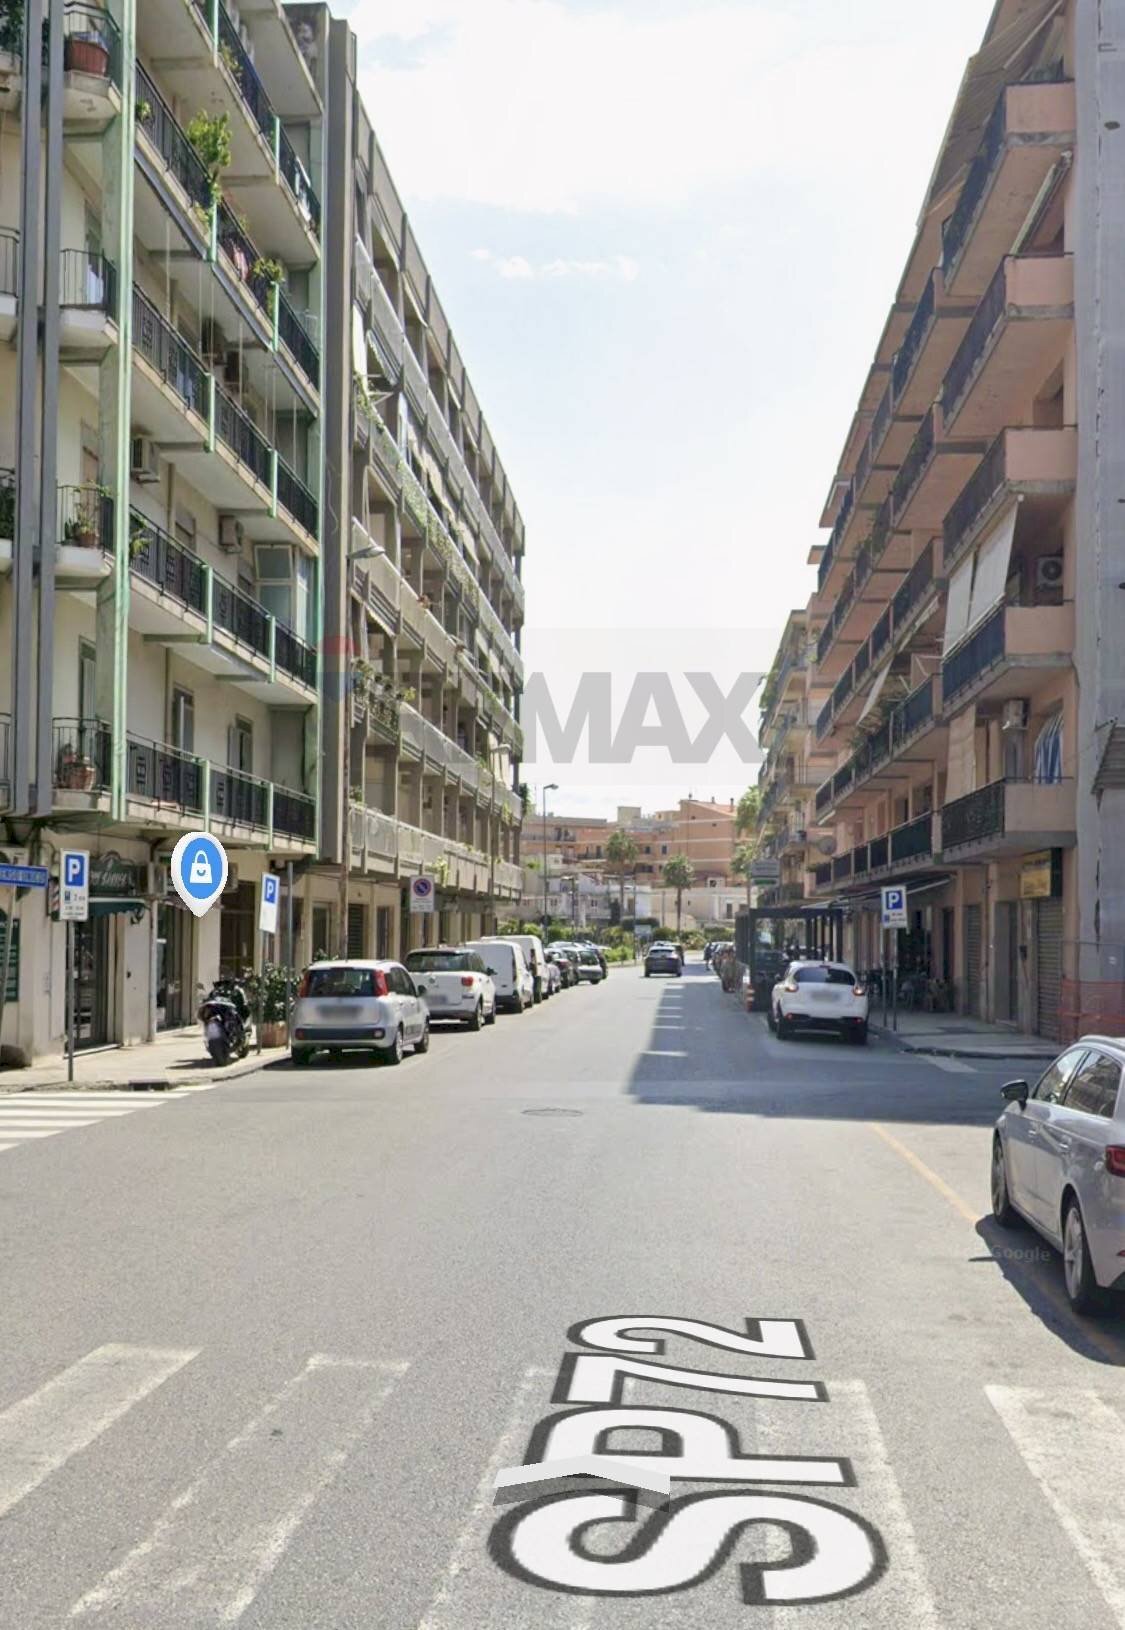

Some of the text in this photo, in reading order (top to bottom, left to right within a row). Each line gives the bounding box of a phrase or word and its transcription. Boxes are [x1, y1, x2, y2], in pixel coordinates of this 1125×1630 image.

[68, 858, 81, 883] P
[267, 881, 274, 899] P
[889, 892, 900, 908] P
